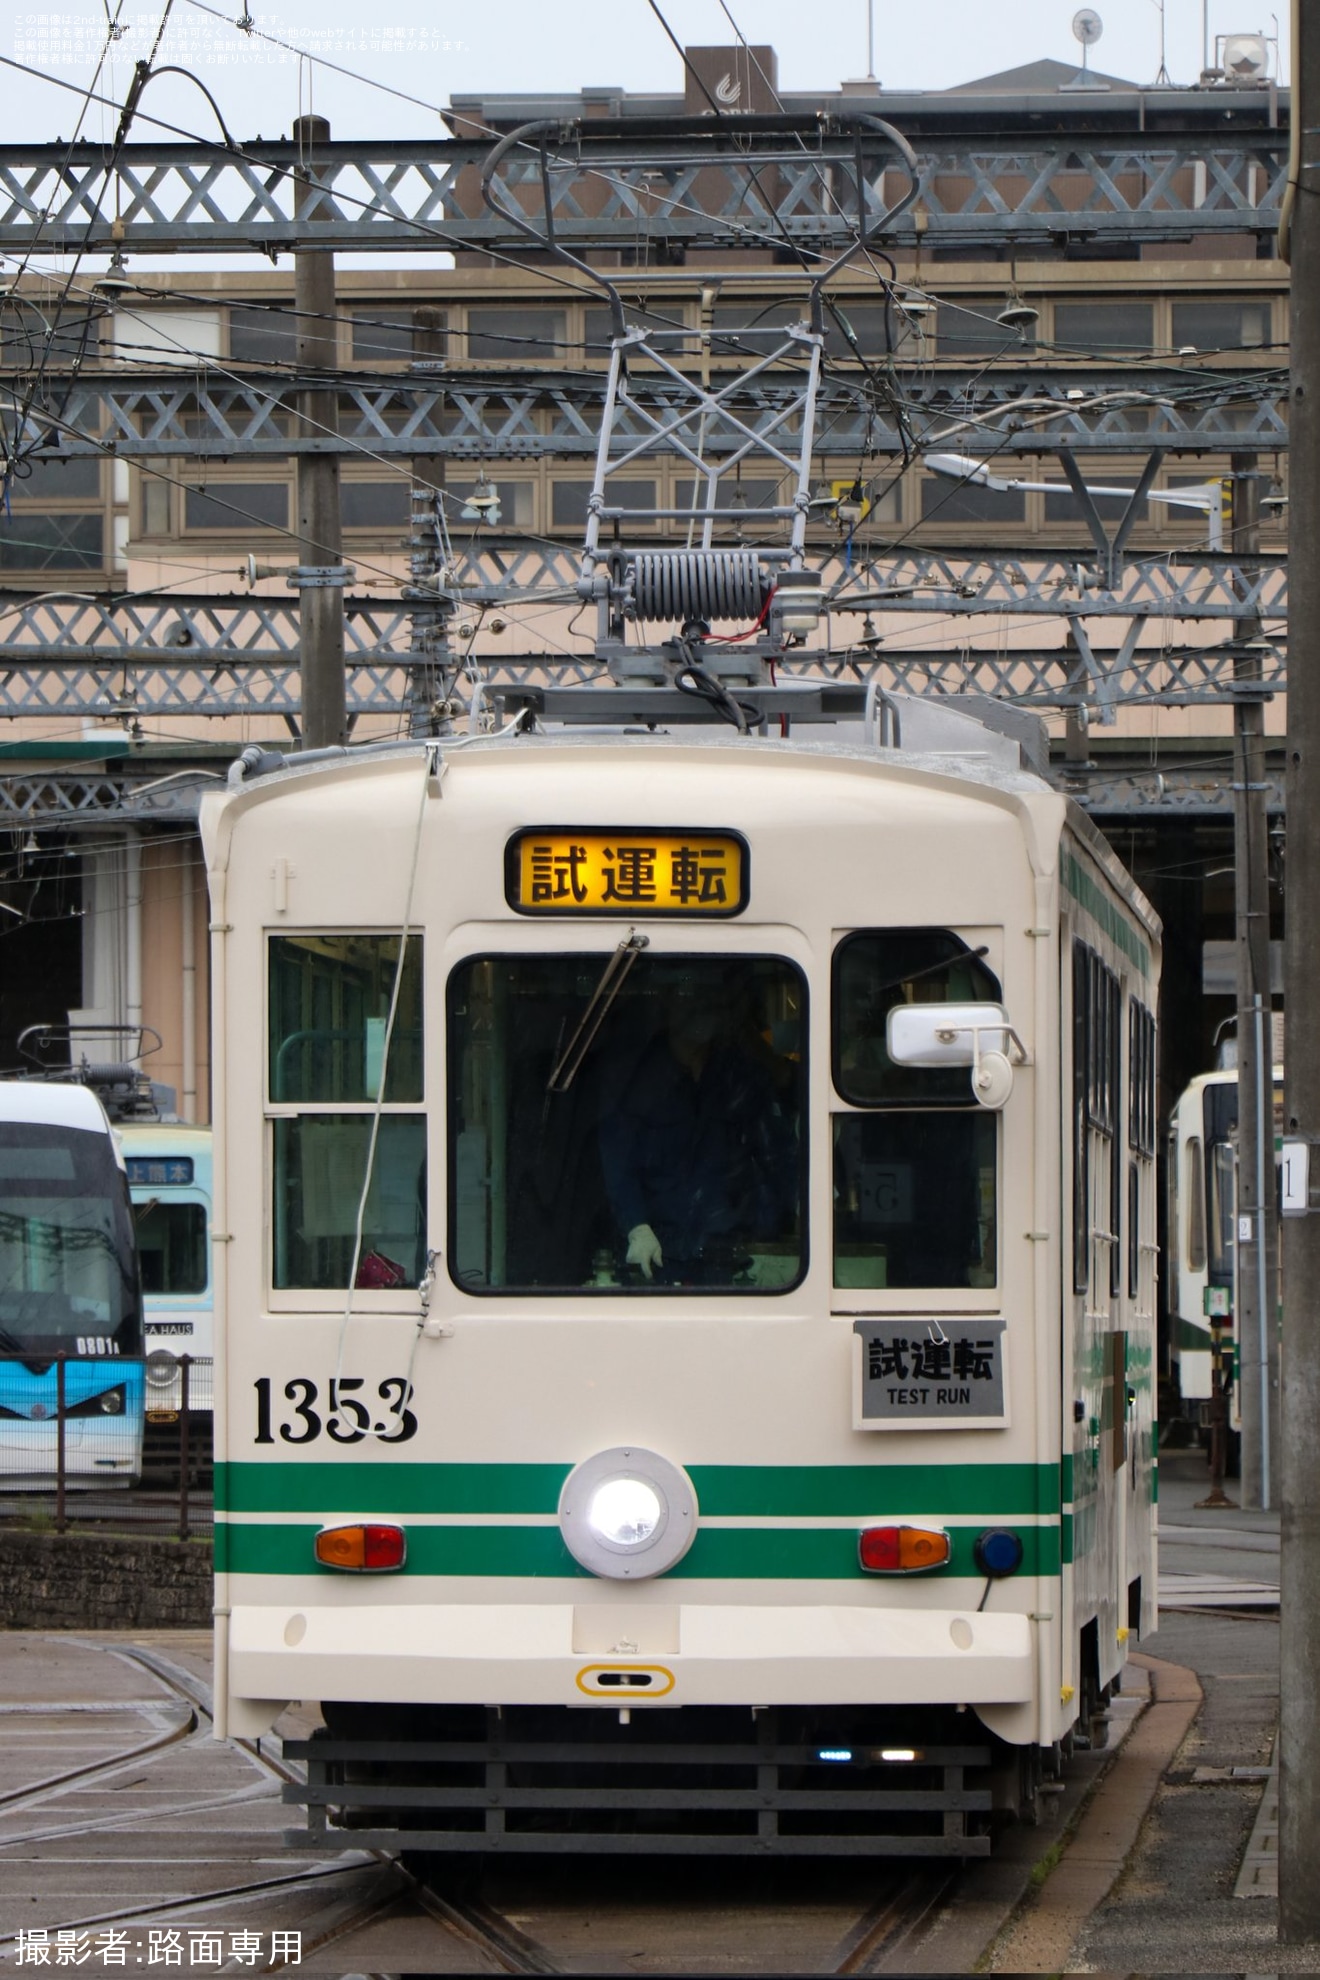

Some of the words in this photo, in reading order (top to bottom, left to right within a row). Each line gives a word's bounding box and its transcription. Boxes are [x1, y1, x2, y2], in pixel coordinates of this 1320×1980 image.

[531, 845, 728, 904] 試運転
[1284, 1157, 1295, 1198] 1
[161, 1325, 192, 1335] HAUS
[868, 1337, 995, 1381] 試運転
[253, 1377, 418, 1444] 1353
[887, 1388, 930, 1405] TEST
[937, 1388, 970, 1405] RUN
